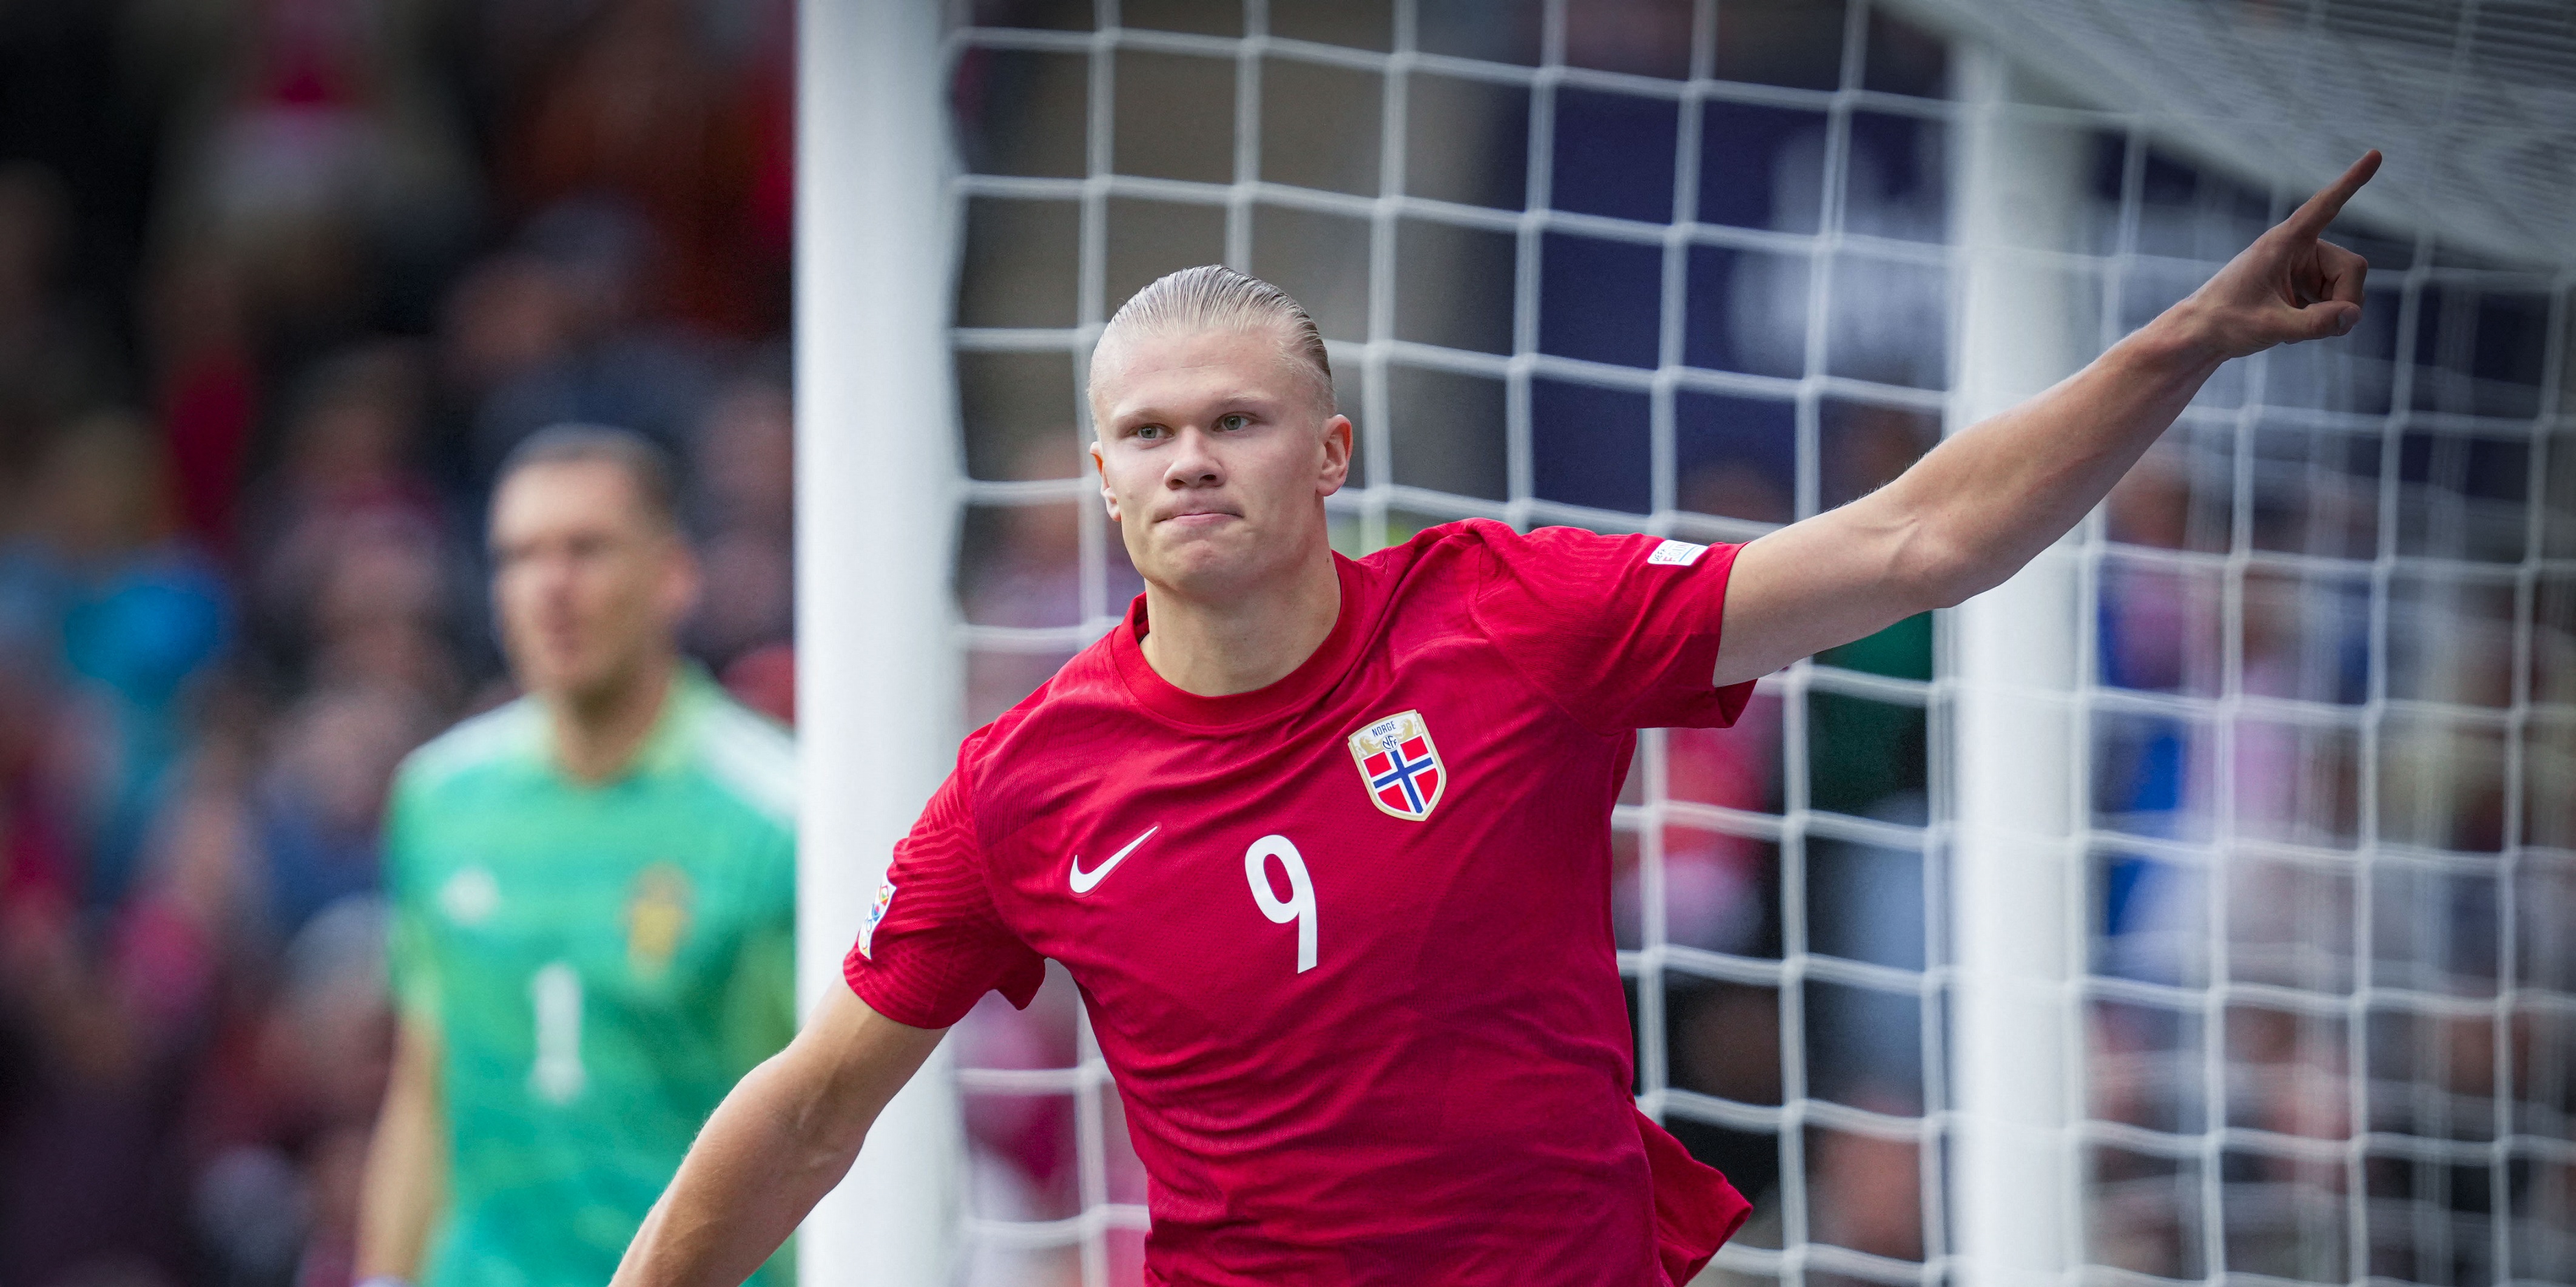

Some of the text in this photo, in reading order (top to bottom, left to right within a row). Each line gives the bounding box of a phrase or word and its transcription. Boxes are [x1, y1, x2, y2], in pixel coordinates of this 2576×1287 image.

[1372, 721, 1397, 737] NORGE
[1245, 834, 1318, 974] 9
[528, 962, 585, 1103] 1
